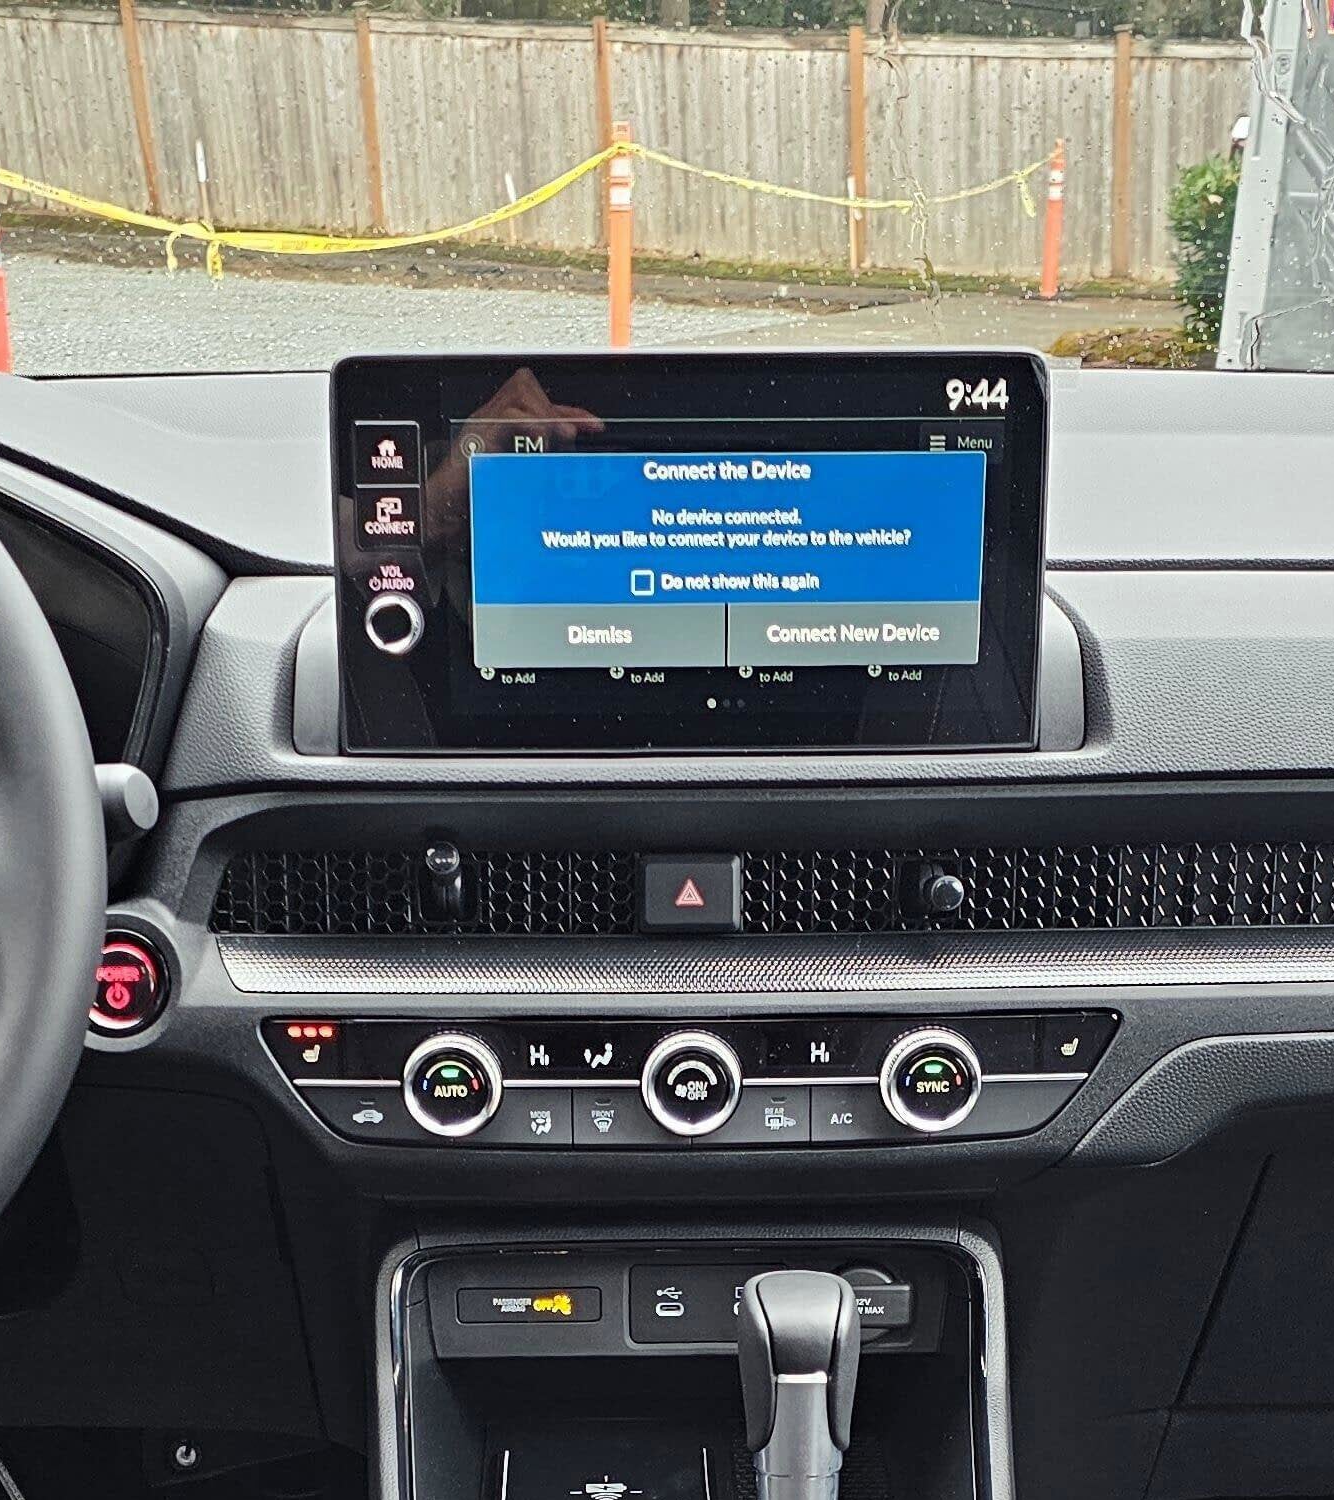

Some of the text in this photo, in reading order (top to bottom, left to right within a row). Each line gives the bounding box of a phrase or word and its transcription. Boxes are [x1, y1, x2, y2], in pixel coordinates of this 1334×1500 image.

[946, 378, 1009, 411] 9:44
[514, 435, 544, 453] FM
[957, 435, 992, 449] Menu
[371, 456, 404, 469] HOME
[644, 460, 811, 481] Connect the Device
[652, 508, 802, 525] No device connected.
[364, 521, 415, 535] CONNECT
[542, 529, 912, 549] Would you like to connect your device to the vehicle?
[380, 565, 403, 578] VOL
[382, 577, 414, 591] AUDIO
[661, 573, 820, 591] Do not show this again
[568, 625, 632, 644] Dismiss
[767, 623, 940, 643] Connect New Device
[502, 673, 535, 684] to Add
[631, 672, 664, 684] to Add
[759, 671, 793, 682] to Add
[889, 670, 921, 681] to Add
[434, 1085, 468, 1098] AUTO
[916, 1081, 950, 1094] SYNC
[591, 1110, 614, 1118] FRONT
[764, 1107, 785, 1115] REAR
[830, 1112, 853, 1125] A/C
[865, 1306, 884, 1315] MAX
